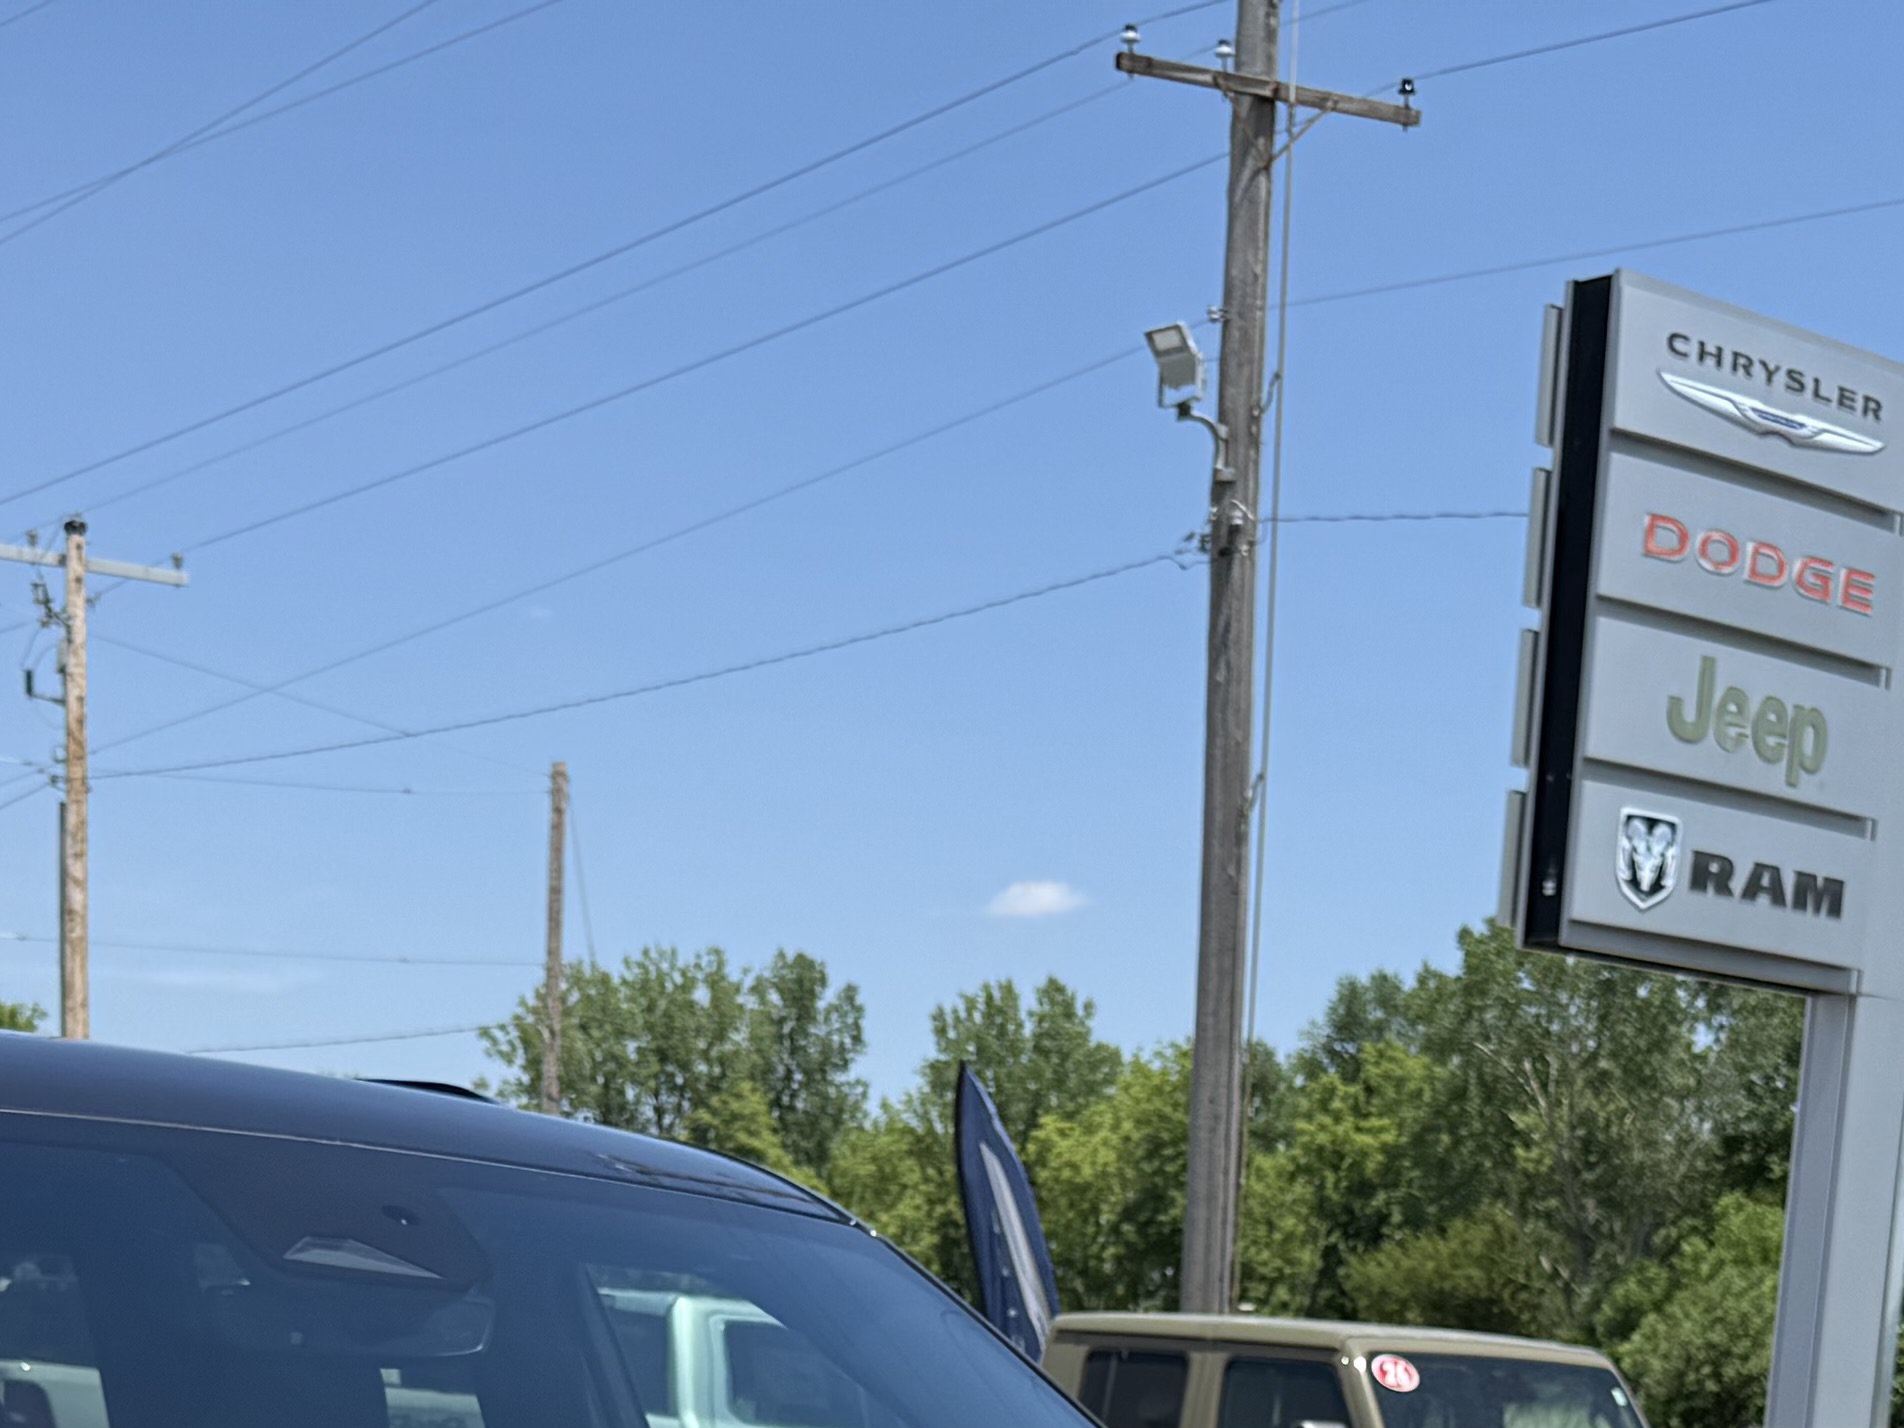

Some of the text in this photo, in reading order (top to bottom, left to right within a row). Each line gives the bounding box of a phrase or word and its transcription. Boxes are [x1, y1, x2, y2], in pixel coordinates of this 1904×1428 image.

[1667, 331, 1884, 424] CHRYSLER
[1642, 511, 1878, 617] DODGE
[1667, 655, 1828, 788] Jeep
[1689, 848, 1846, 921] RAM
